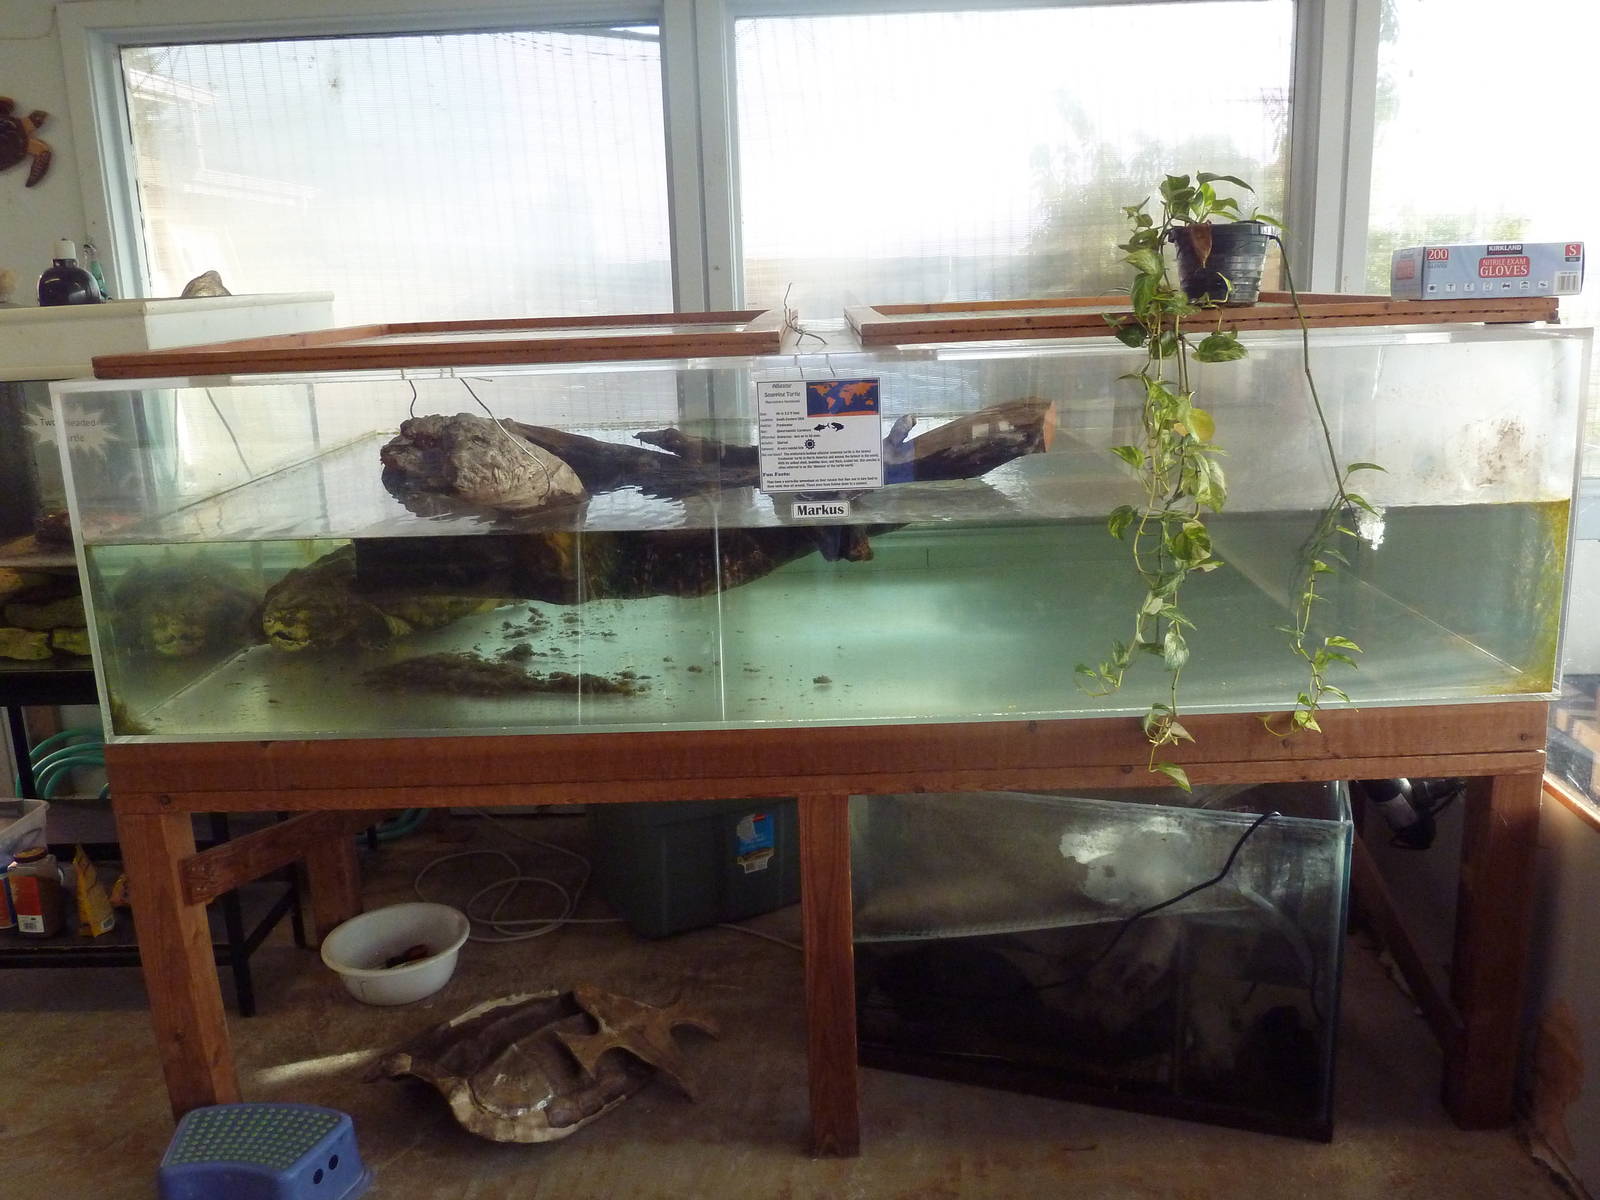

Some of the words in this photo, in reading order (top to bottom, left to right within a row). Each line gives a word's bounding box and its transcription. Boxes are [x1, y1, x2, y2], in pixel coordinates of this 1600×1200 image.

[1428, 249, 1448, 260] 200
[1568, 244, 1577, 256] S
[1482, 258, 1506, 266] NITRILE
[1506, 257, 1527, 265] EXAM
[1480, 265, 1528, 276] GLOVES
[797, 505, 844, 515] Markus
